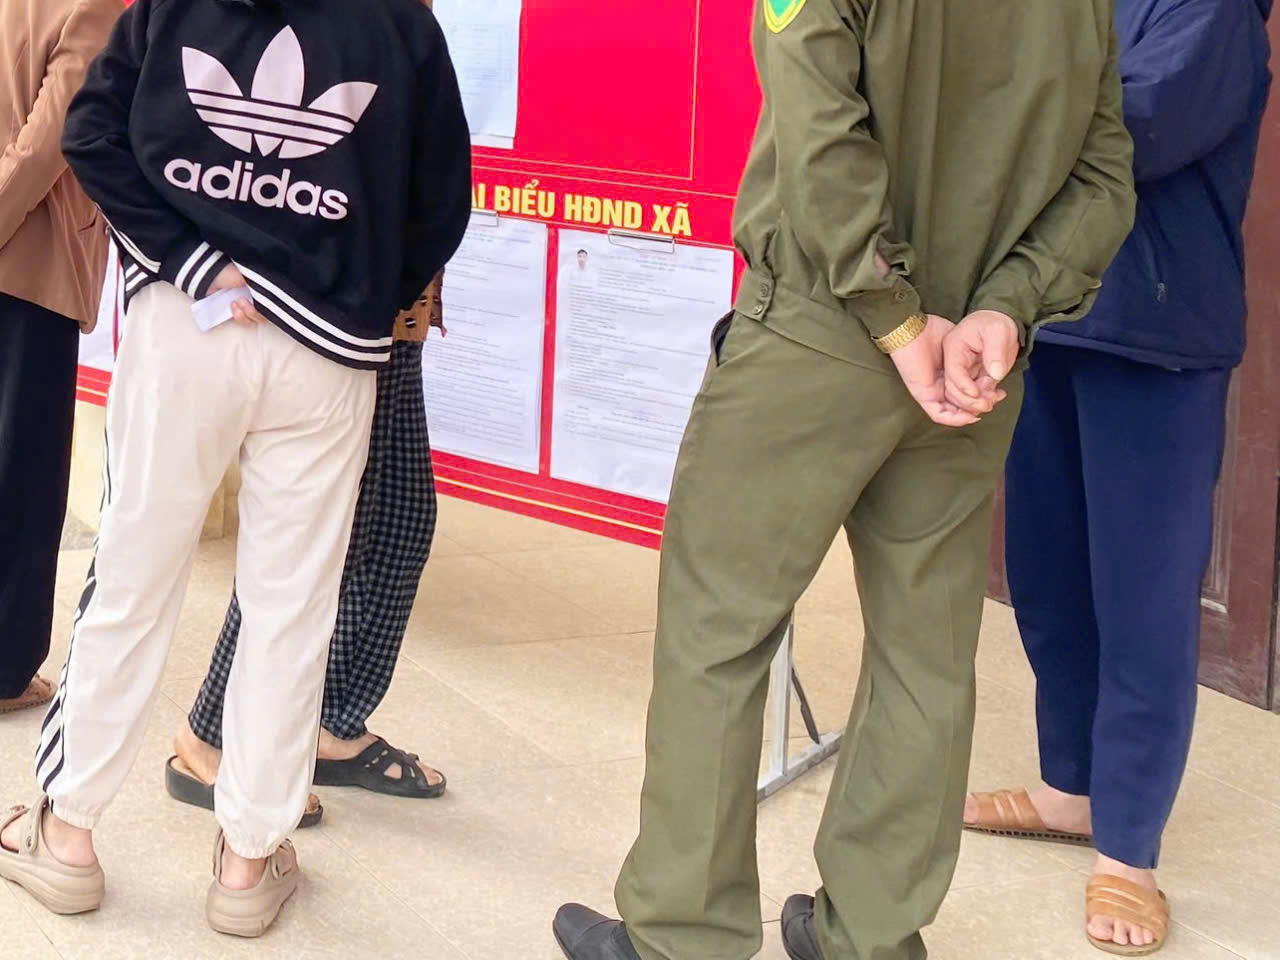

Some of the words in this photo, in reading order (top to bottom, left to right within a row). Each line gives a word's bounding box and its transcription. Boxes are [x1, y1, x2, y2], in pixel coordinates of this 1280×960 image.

[163, 157, 349, 221] adidas
[494, 178, 556, 218] BIỂU
[564, 193, 643, 229] HĐND
[651, 201, 693, 237] XÃ
